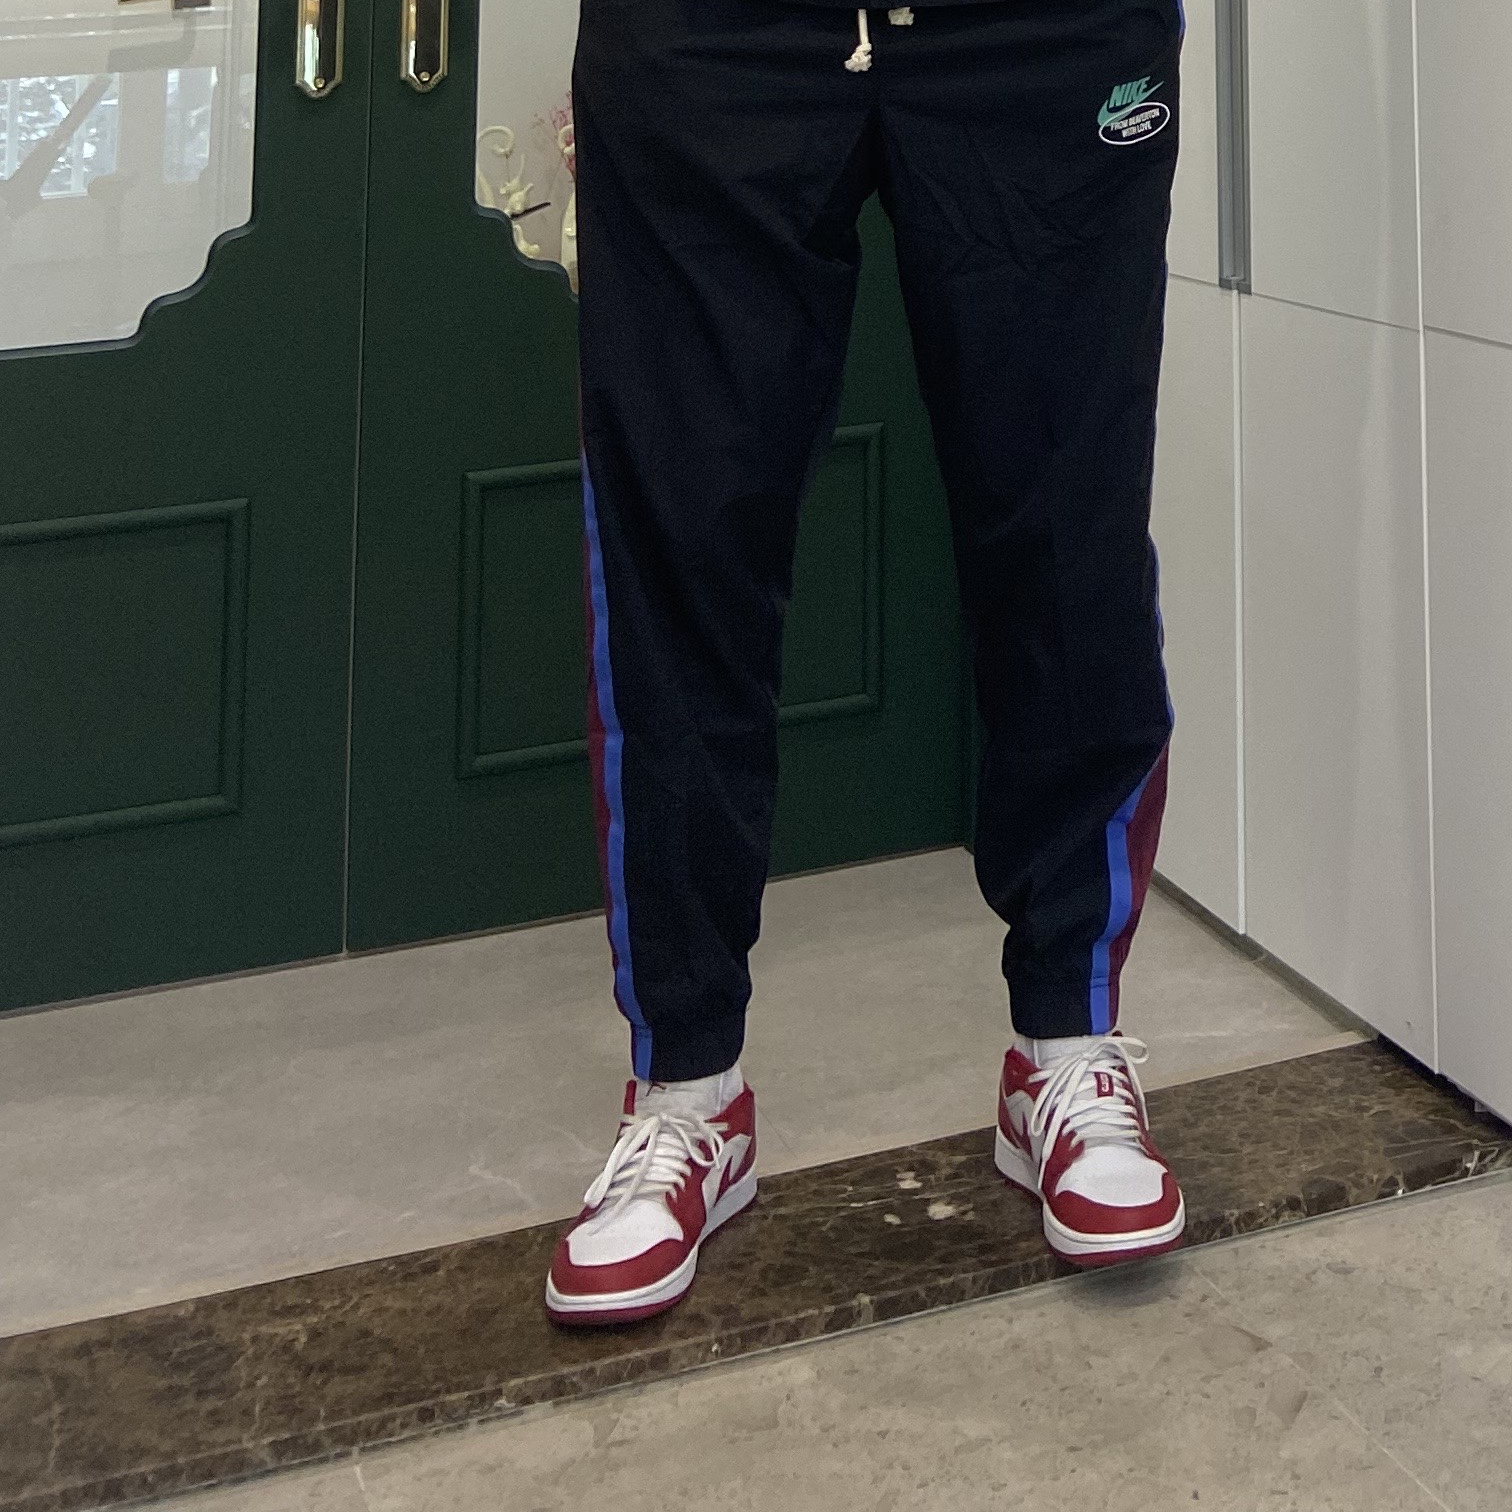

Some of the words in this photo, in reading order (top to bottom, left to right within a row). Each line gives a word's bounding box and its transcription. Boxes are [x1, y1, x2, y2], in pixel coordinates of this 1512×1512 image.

[1108, 76, 1151, 108] NIKE
[1110, 119, 1129, 132] FROM
[1137, 120, 1152, 133] LOVE
